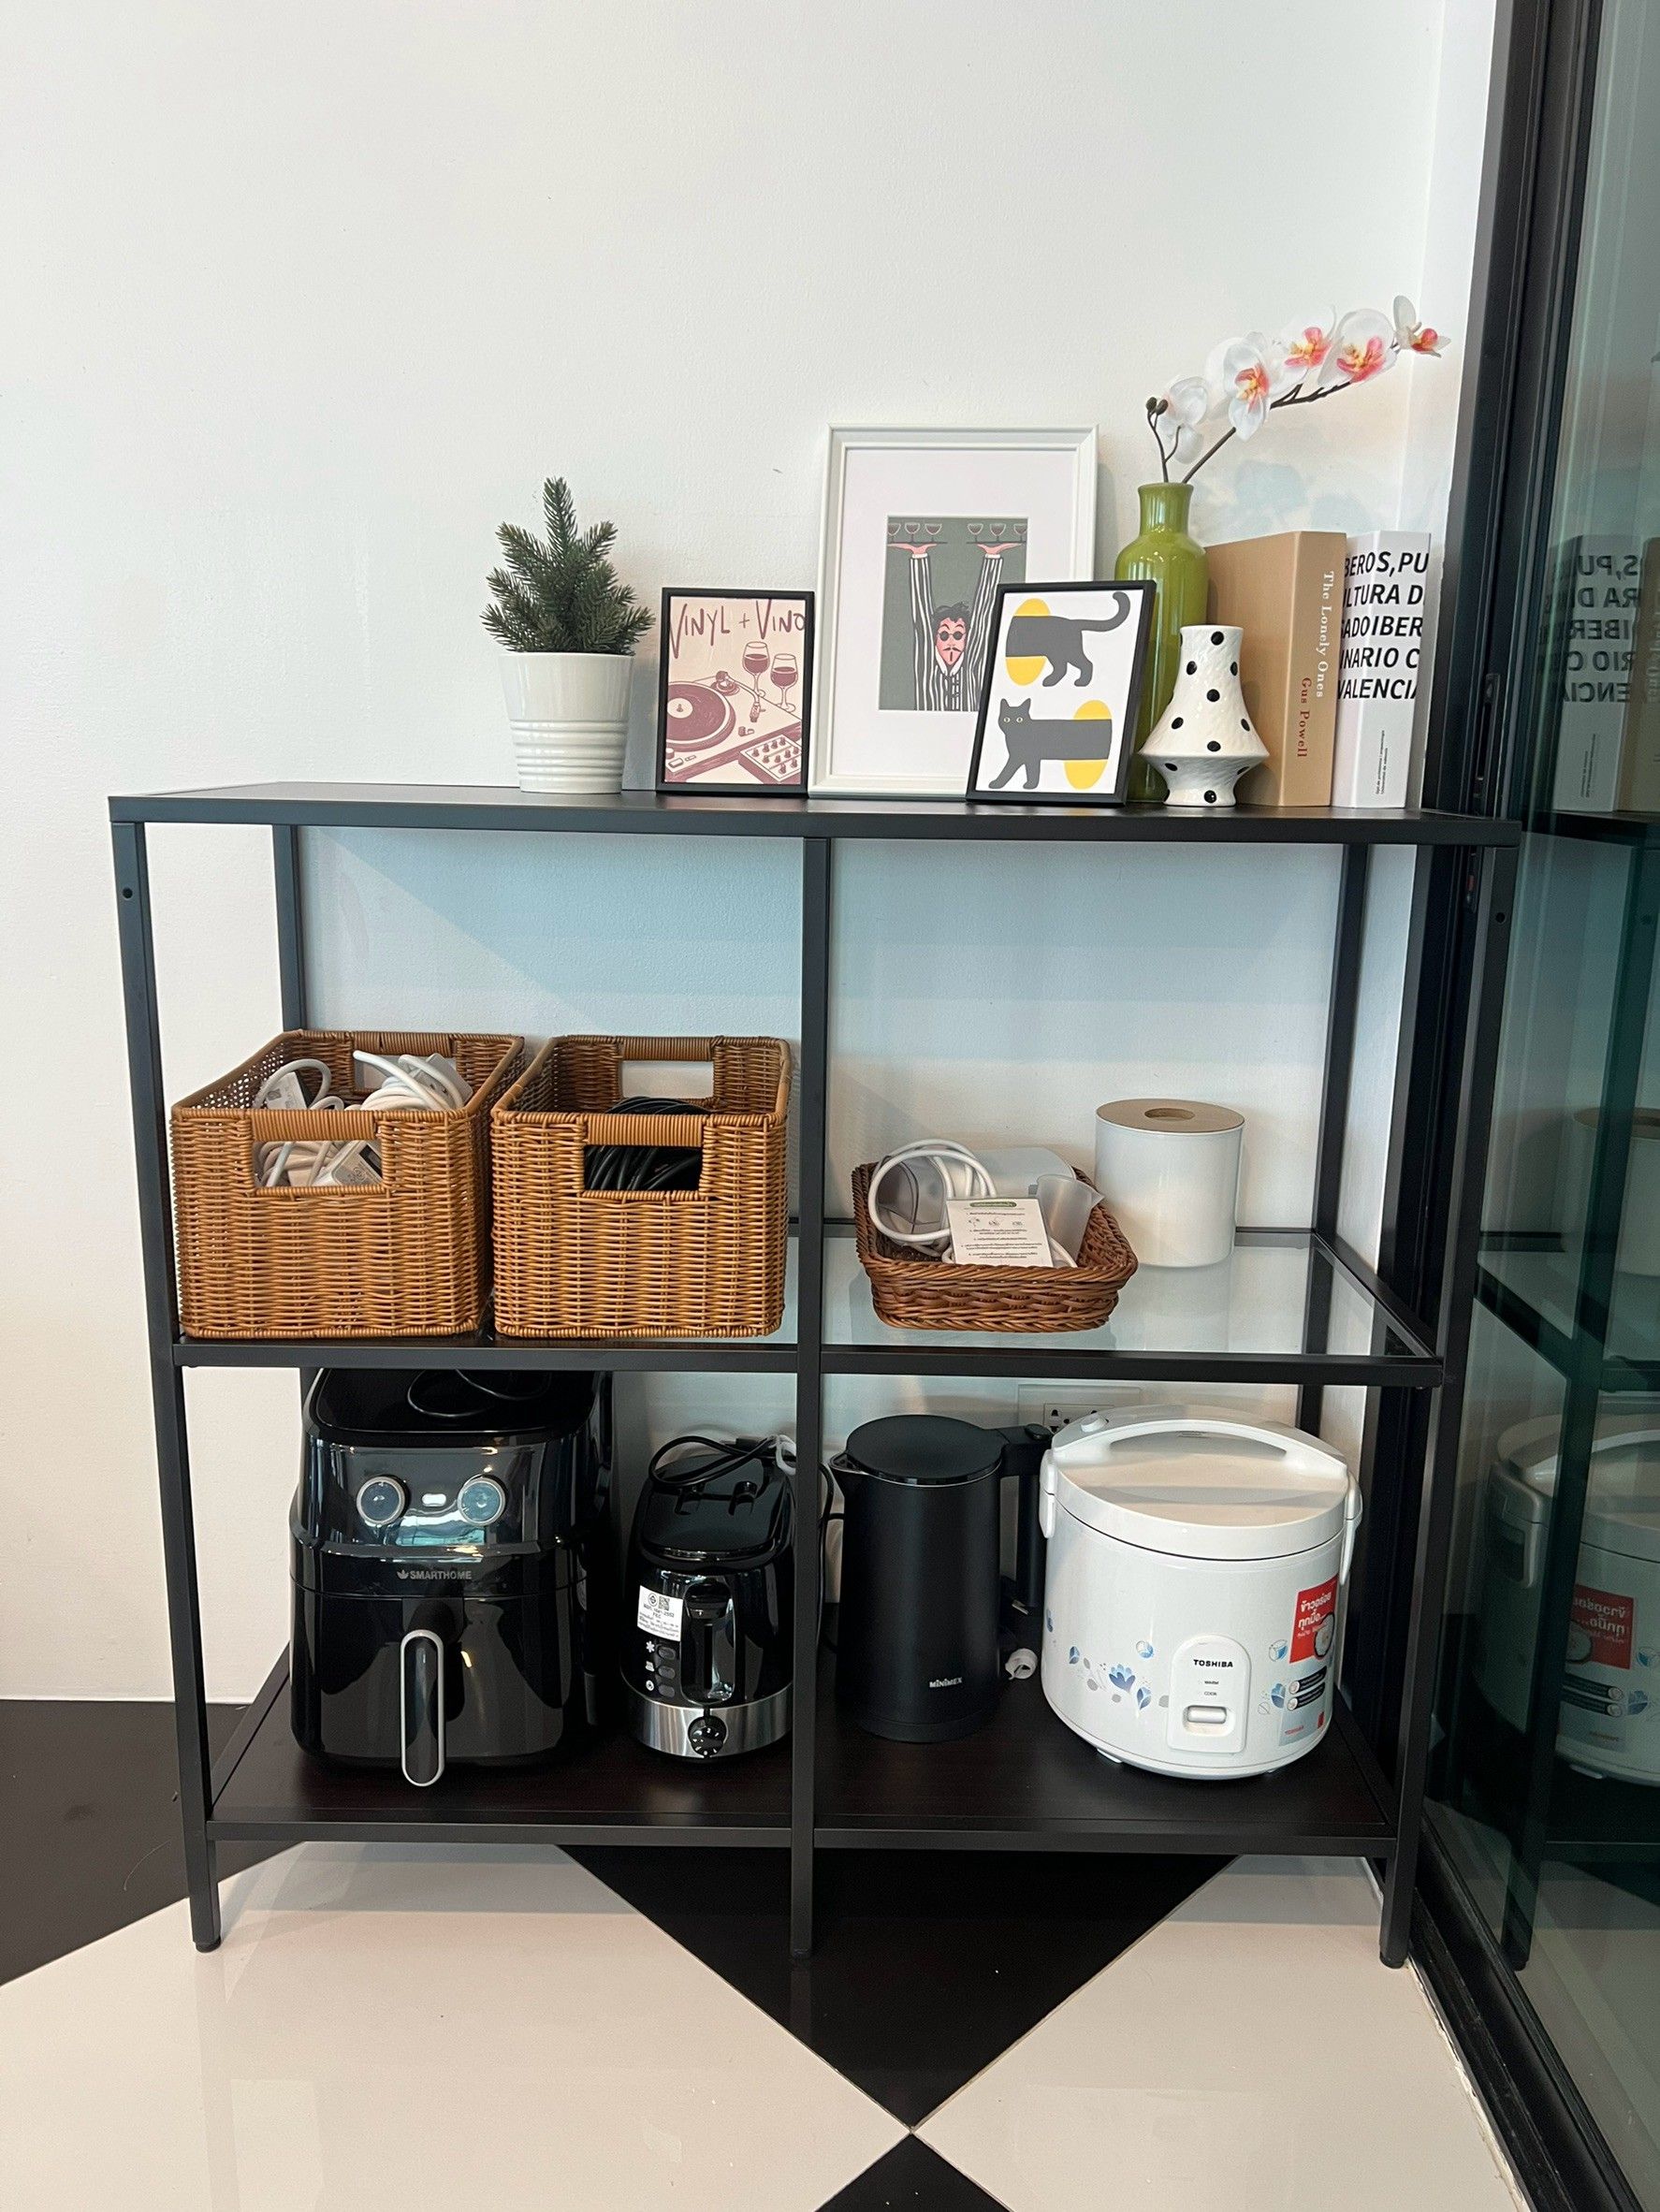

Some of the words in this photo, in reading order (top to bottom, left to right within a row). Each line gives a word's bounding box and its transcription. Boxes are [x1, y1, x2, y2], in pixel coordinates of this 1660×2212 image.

[1322, 571, 1334, 600] The
[669, 604, 731, 660] VINYL
[755, 599, 807, 640] VINO
[1316, 605, 1332, 656] Lonely
[1301, 677, 1312, 704] Gus
[1316, 661, 1329, 698] Ones
[1297, 710, 1310, 758] Powell
[410, 1570, 472, 1580] SMARTHOME
[1193, 1659, 1233, 1668] TOSHIBA
